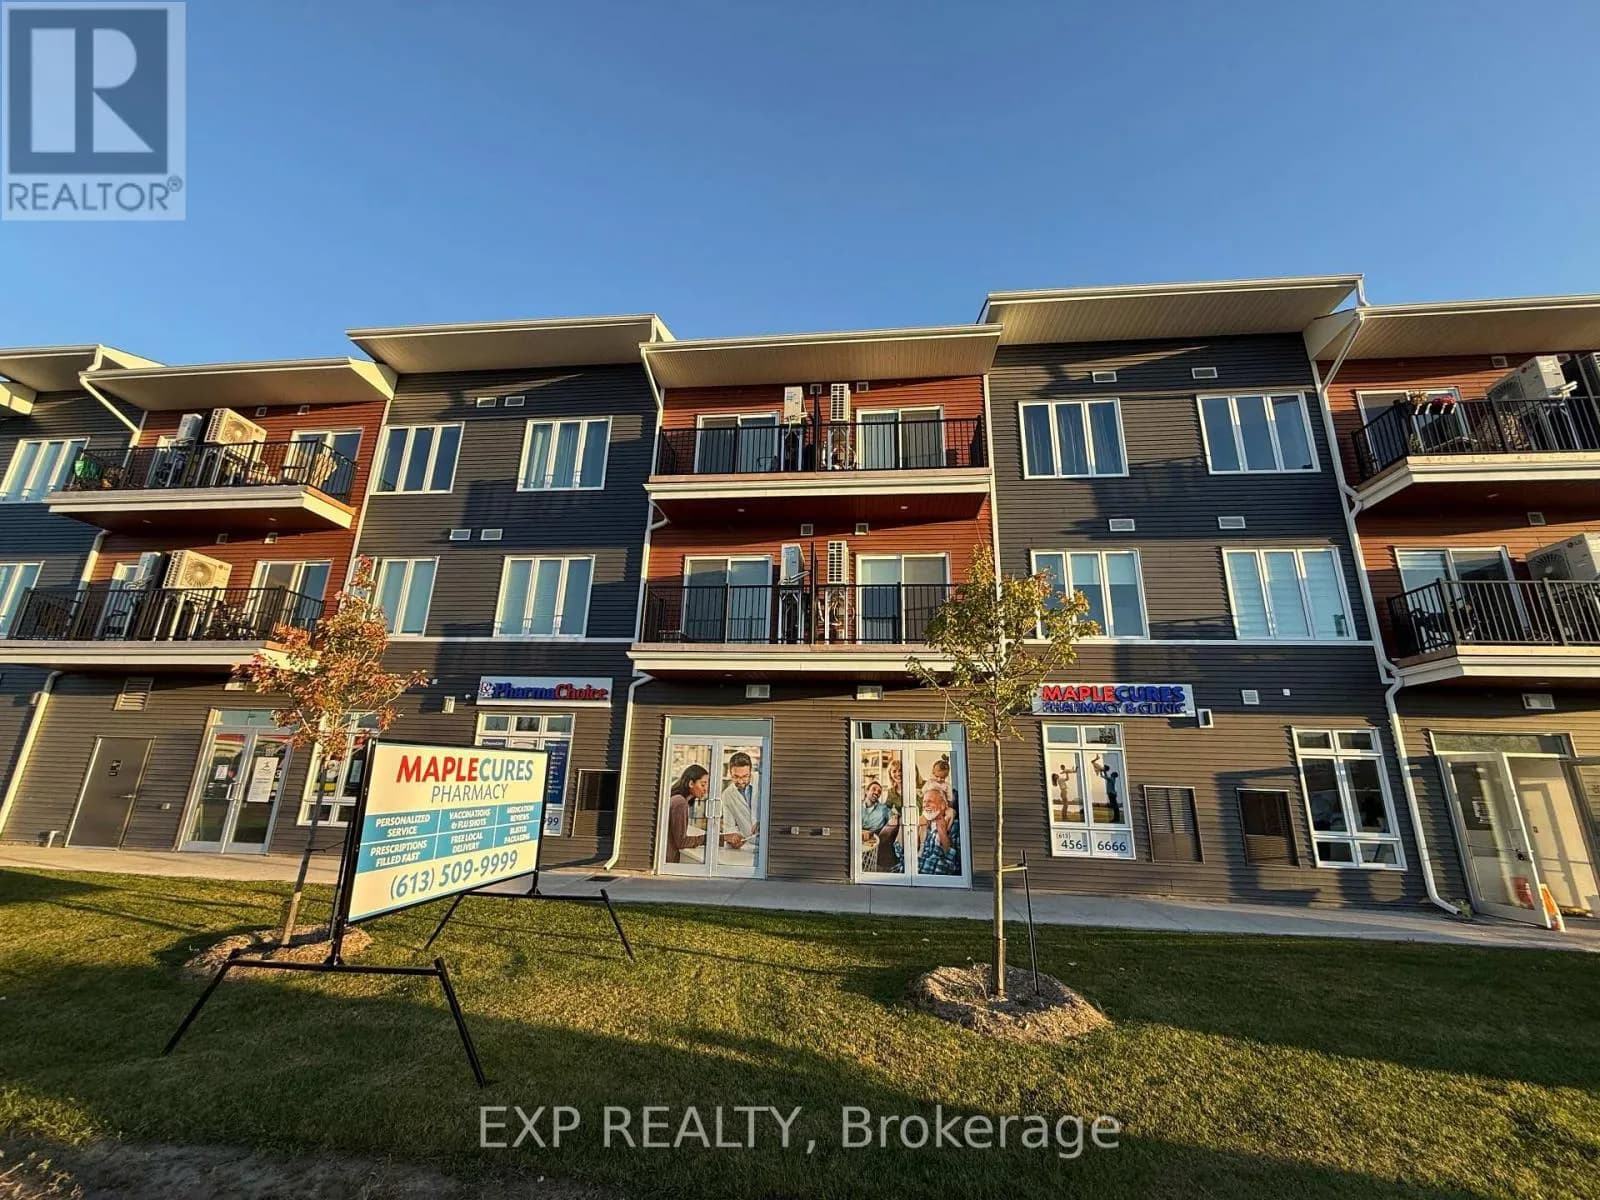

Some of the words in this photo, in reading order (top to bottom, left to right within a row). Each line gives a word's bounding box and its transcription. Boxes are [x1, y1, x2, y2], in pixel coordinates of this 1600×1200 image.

[494, 682, 609, 700] PharmaChoice
[1042, 685, 1186, 703] MAPLECURES
[1042, 702, 1122, 713] PHARMACY
[1125, 703, 1136, 714] &
[1138, 702, 1186, 714] CLINIC
[396, 755, 534, 783] MAPLECURES
[431, 784, 509, 803] PHARMACY
[375, 814, 431, 827] PERSONALIZED
[449, 808, 492, 820] VACCINATIONS
[387, 826, 418, 837] SERVICE
[451, 833, 466, 844] FREE
[466, 831, 483, 842] LOCAL
[370, 840, 428, 856] PRESCRIPTIONS
[452, 841, 480, 853] DELIVERY
[1061, 840, 1088, 850] 456-
[1097, 841, 1127, 852] 6666
[376, 854, 401, 868] FILLED
[402, 852, 420, 862] FAST
[390, 867, 435, 900] (613)
[438, 849, 518, 887] 509-9999
